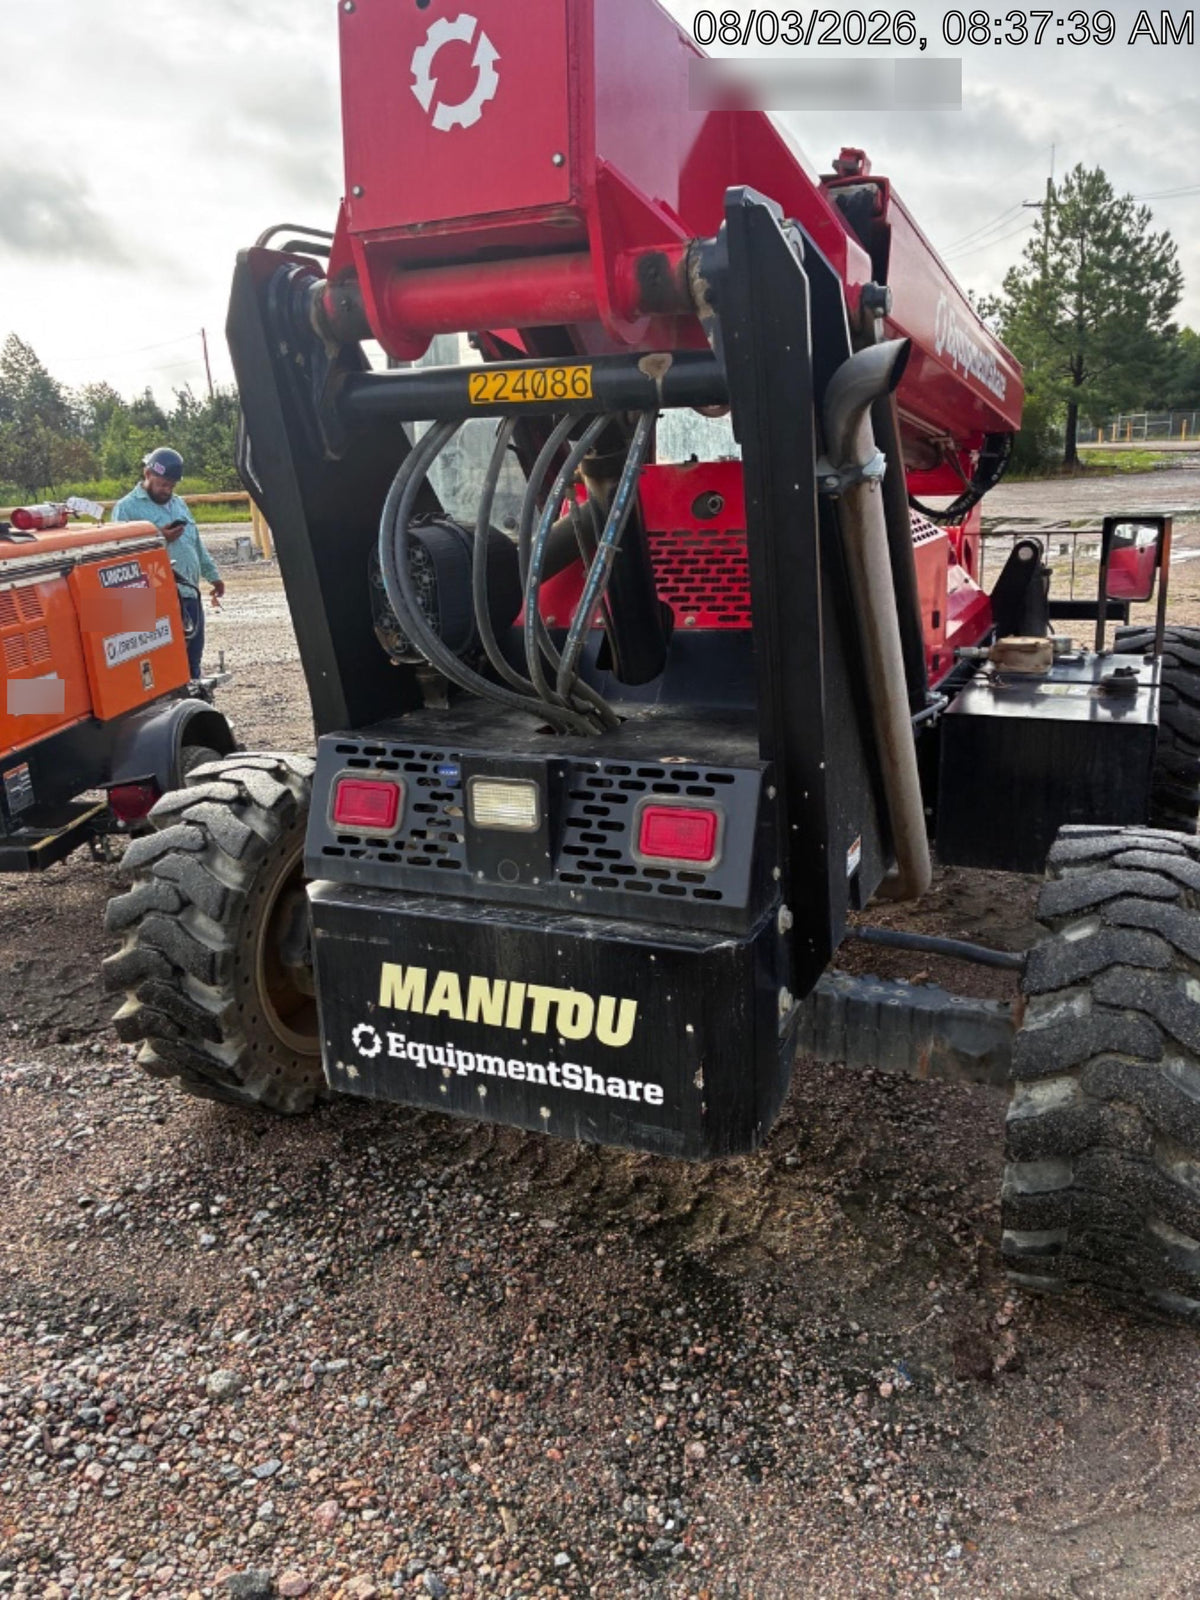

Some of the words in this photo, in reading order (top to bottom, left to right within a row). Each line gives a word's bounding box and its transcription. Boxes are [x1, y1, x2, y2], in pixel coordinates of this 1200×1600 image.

[472, 367, 590, 402] 224086
[100, 564, 141, 587] LINCOLN
[379, 962, 638, 1047] MANITOU
[387, 1031, 664, 1105] EquipmentShare
